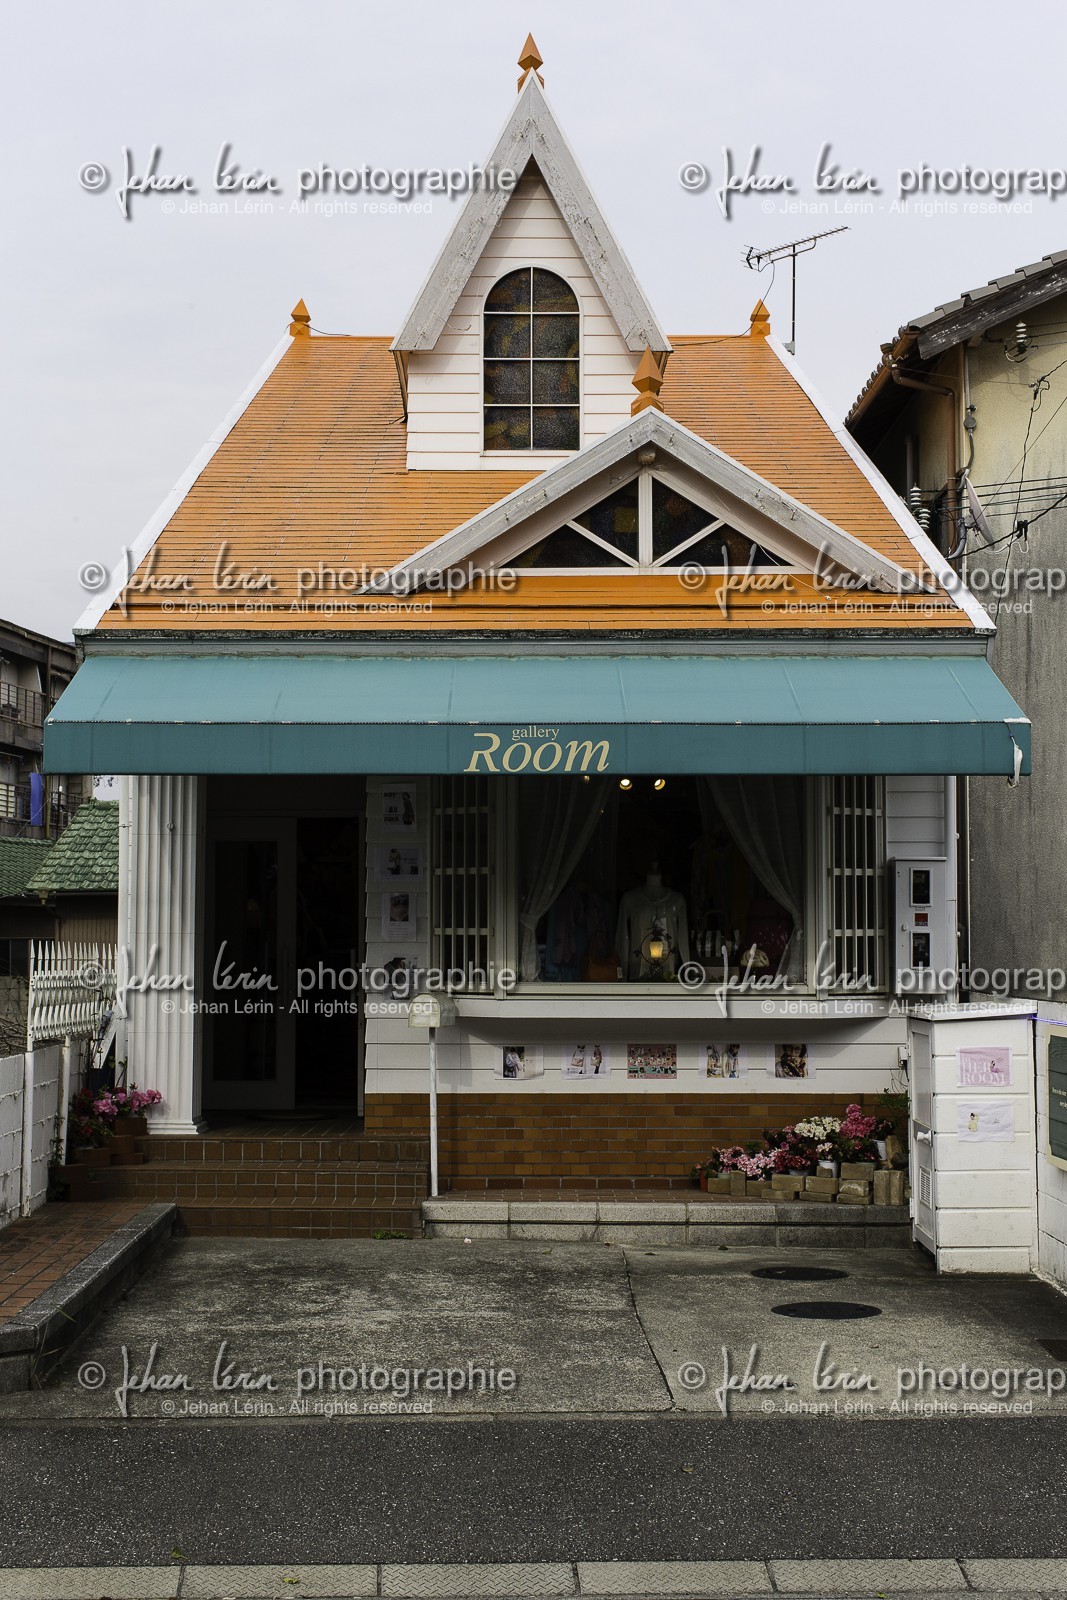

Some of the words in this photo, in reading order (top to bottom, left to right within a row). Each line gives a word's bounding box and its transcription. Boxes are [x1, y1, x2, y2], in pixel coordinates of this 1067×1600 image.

[512, 726, 560, 741] gallery
[463, 732, 610, 772] Room
[962, 1073, 1005, 1085] ROOM
